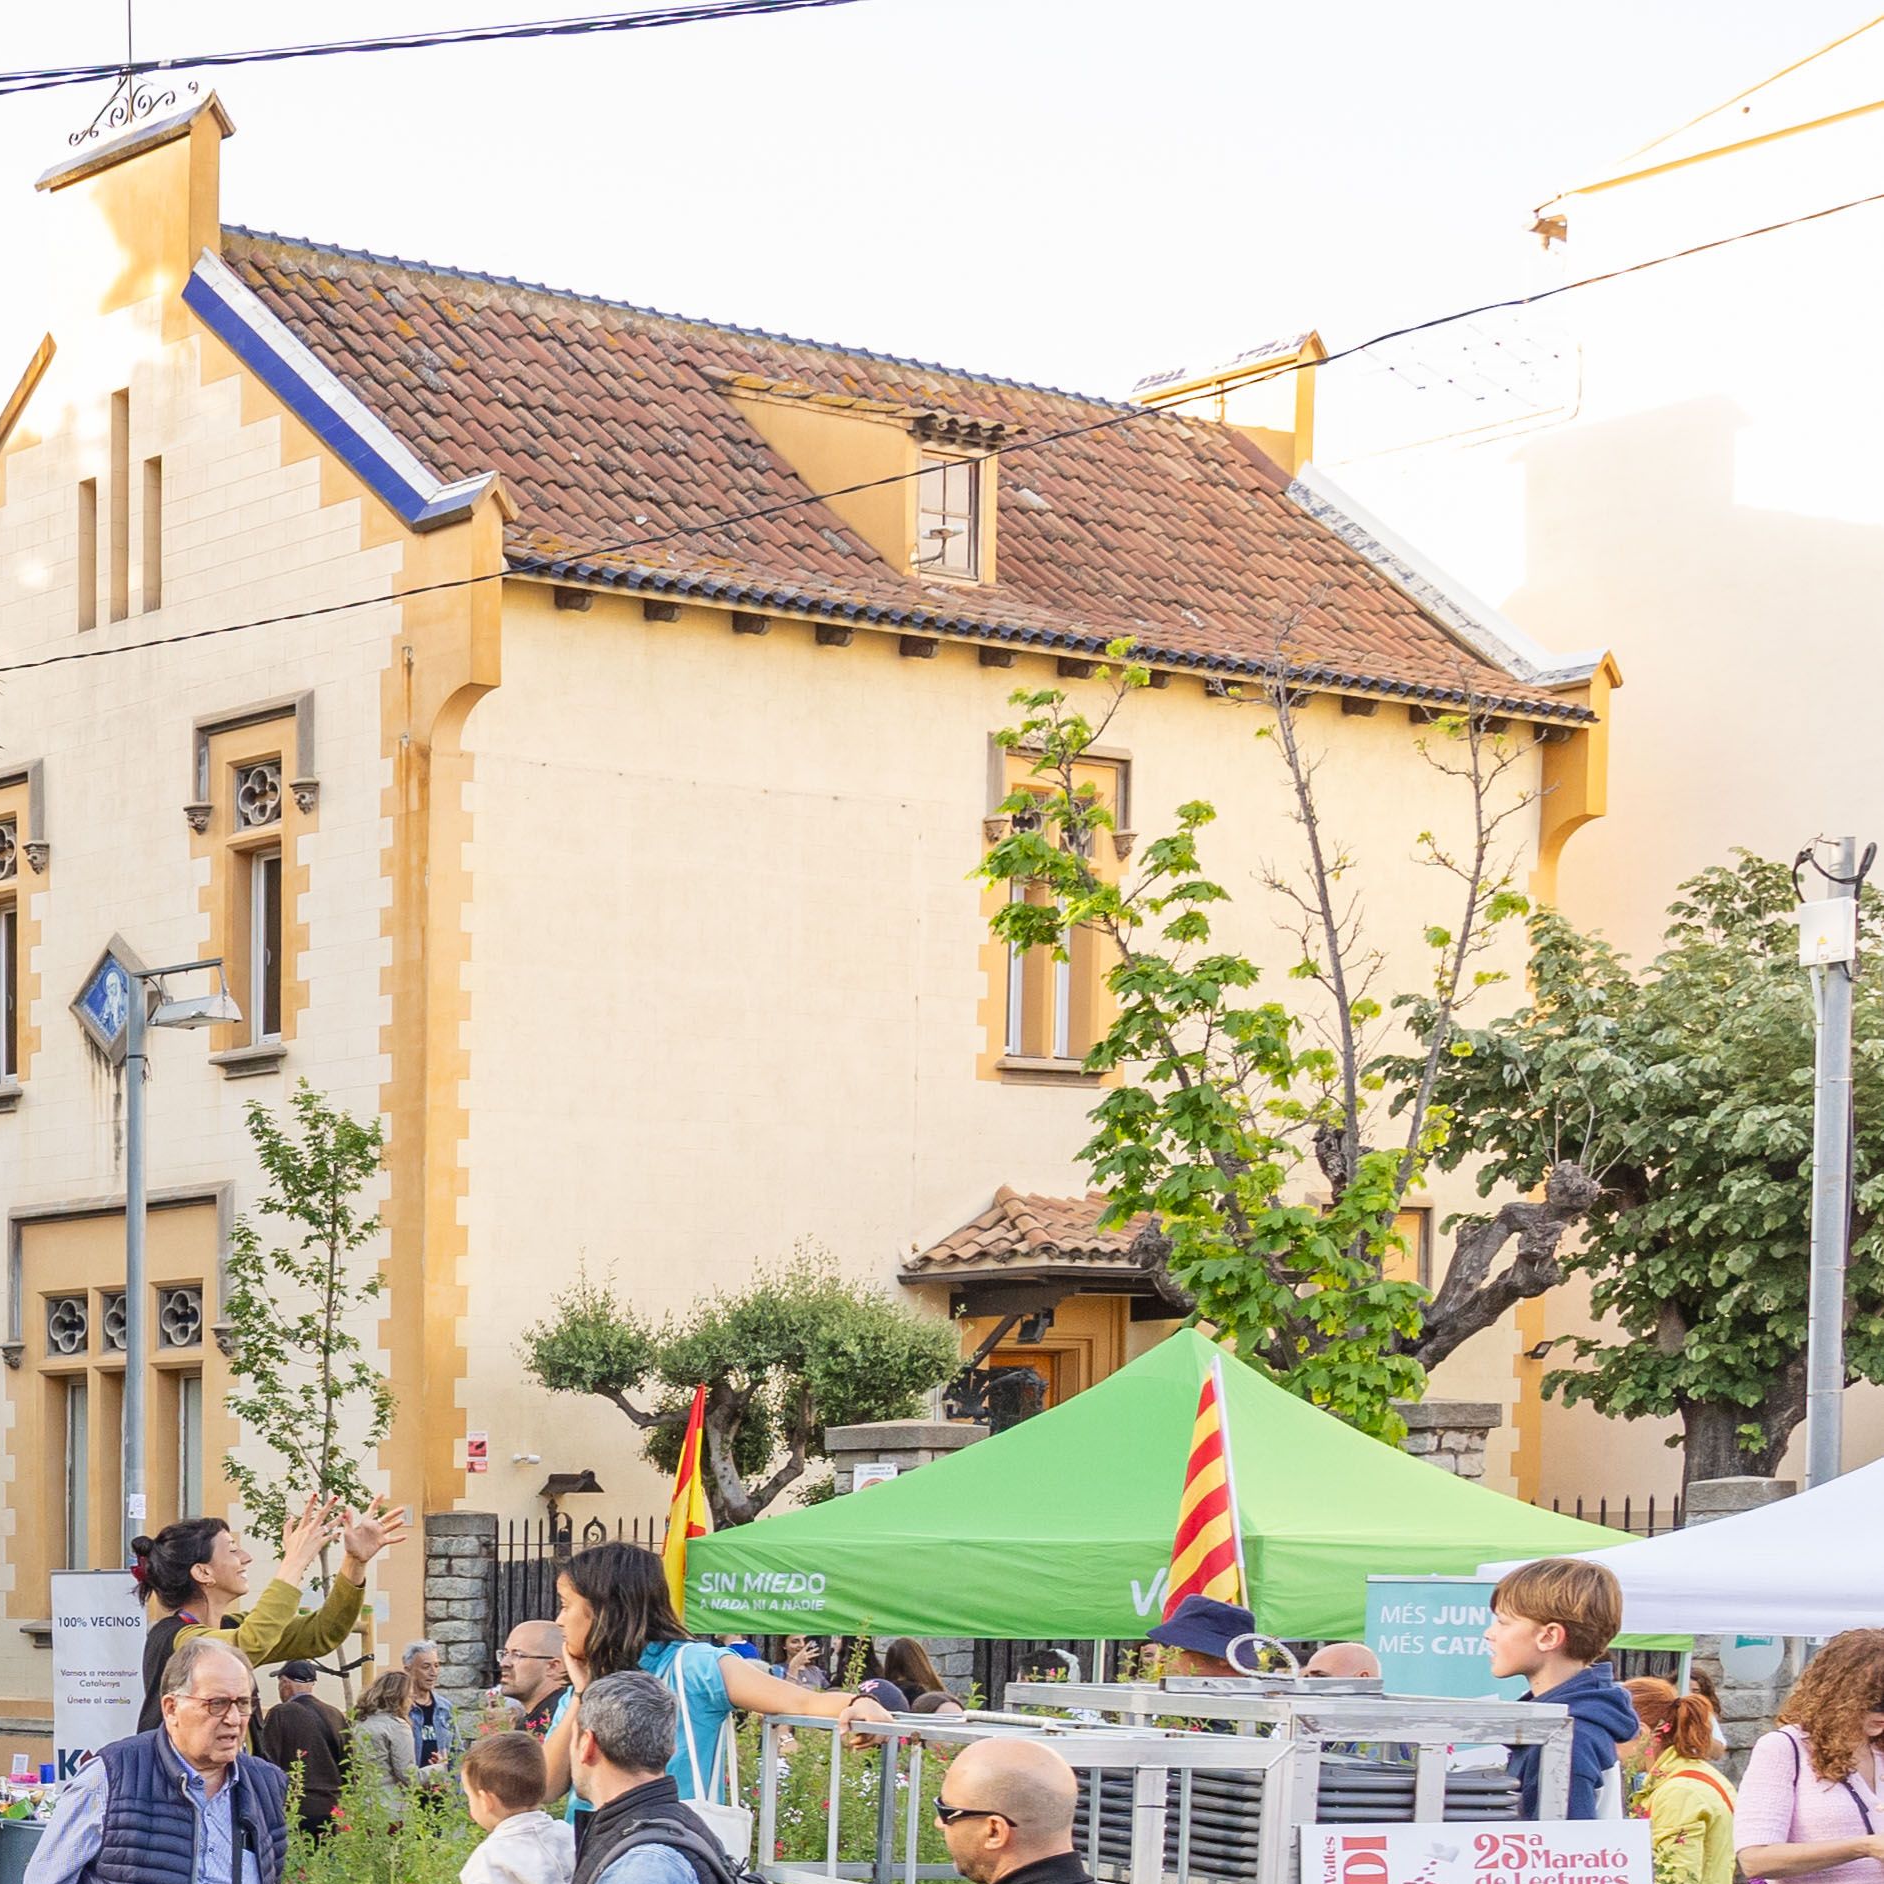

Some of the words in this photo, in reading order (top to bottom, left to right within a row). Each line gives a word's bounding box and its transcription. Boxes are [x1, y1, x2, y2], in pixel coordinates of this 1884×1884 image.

[699, 1572, 737, 1594] SIN
[742, 1571, 826, 1594] MIEDO
[699, 1599, 710, 1610] A
[711, 1599, 750, 1611] NADA
[753, 1599, 766, 1610] NI
[768, 1599, 779, 1611] A
[781, 1599, 826, 1611] NADIE
[1380, 1602, 1426, 1625] MÉS
[58, 1617, 88, 1628] 100%
[90, 1616, 141, 1628] VECINOS
[1378, 1632, 1424, 1654] MÉS
[61, 1669, 87, 1677] Vamos
[97, 1669, 138, 1677] reconstruir
[67, 1695, 91, 1705] Únete
[94, 1696, 102, 1705] al
[104, 1696, 131, 1705] cambio
[1324, 1836, 1336, 1878] Vallès
[1531, 1847, 1628, 1869] Marató
